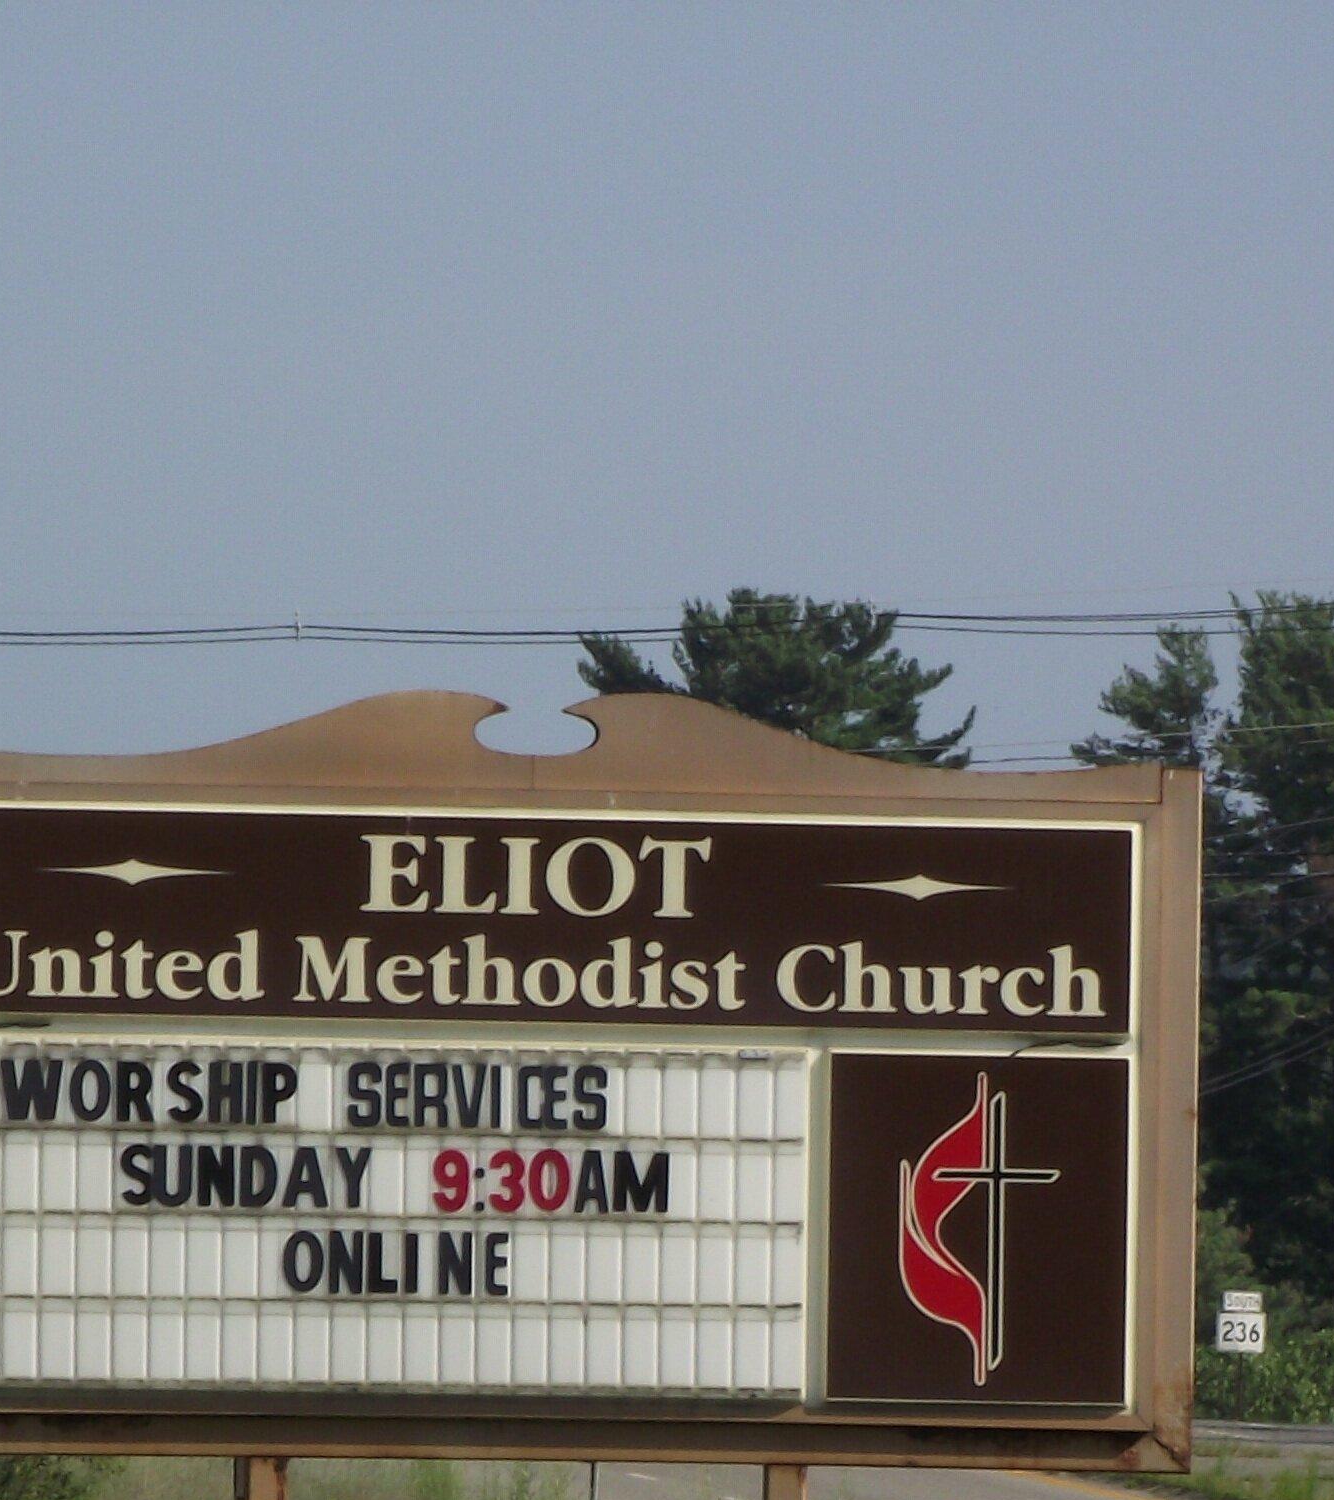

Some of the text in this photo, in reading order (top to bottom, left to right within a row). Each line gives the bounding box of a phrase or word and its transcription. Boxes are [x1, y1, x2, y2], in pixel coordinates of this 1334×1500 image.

[360, 833, 712, 918] ELIOT
[292, 934, 747, 1012] Methodist
[776, 940, 1106, 1018] Church
[0, 1055, 609, 1132] WORSHIP SERVICES
[119, 1142, 670, 1215] SUNDAY 9:30AM
[282, 1229, 510, 1297] ONLINE
[1222, 1320, 1260, 1343] 236
